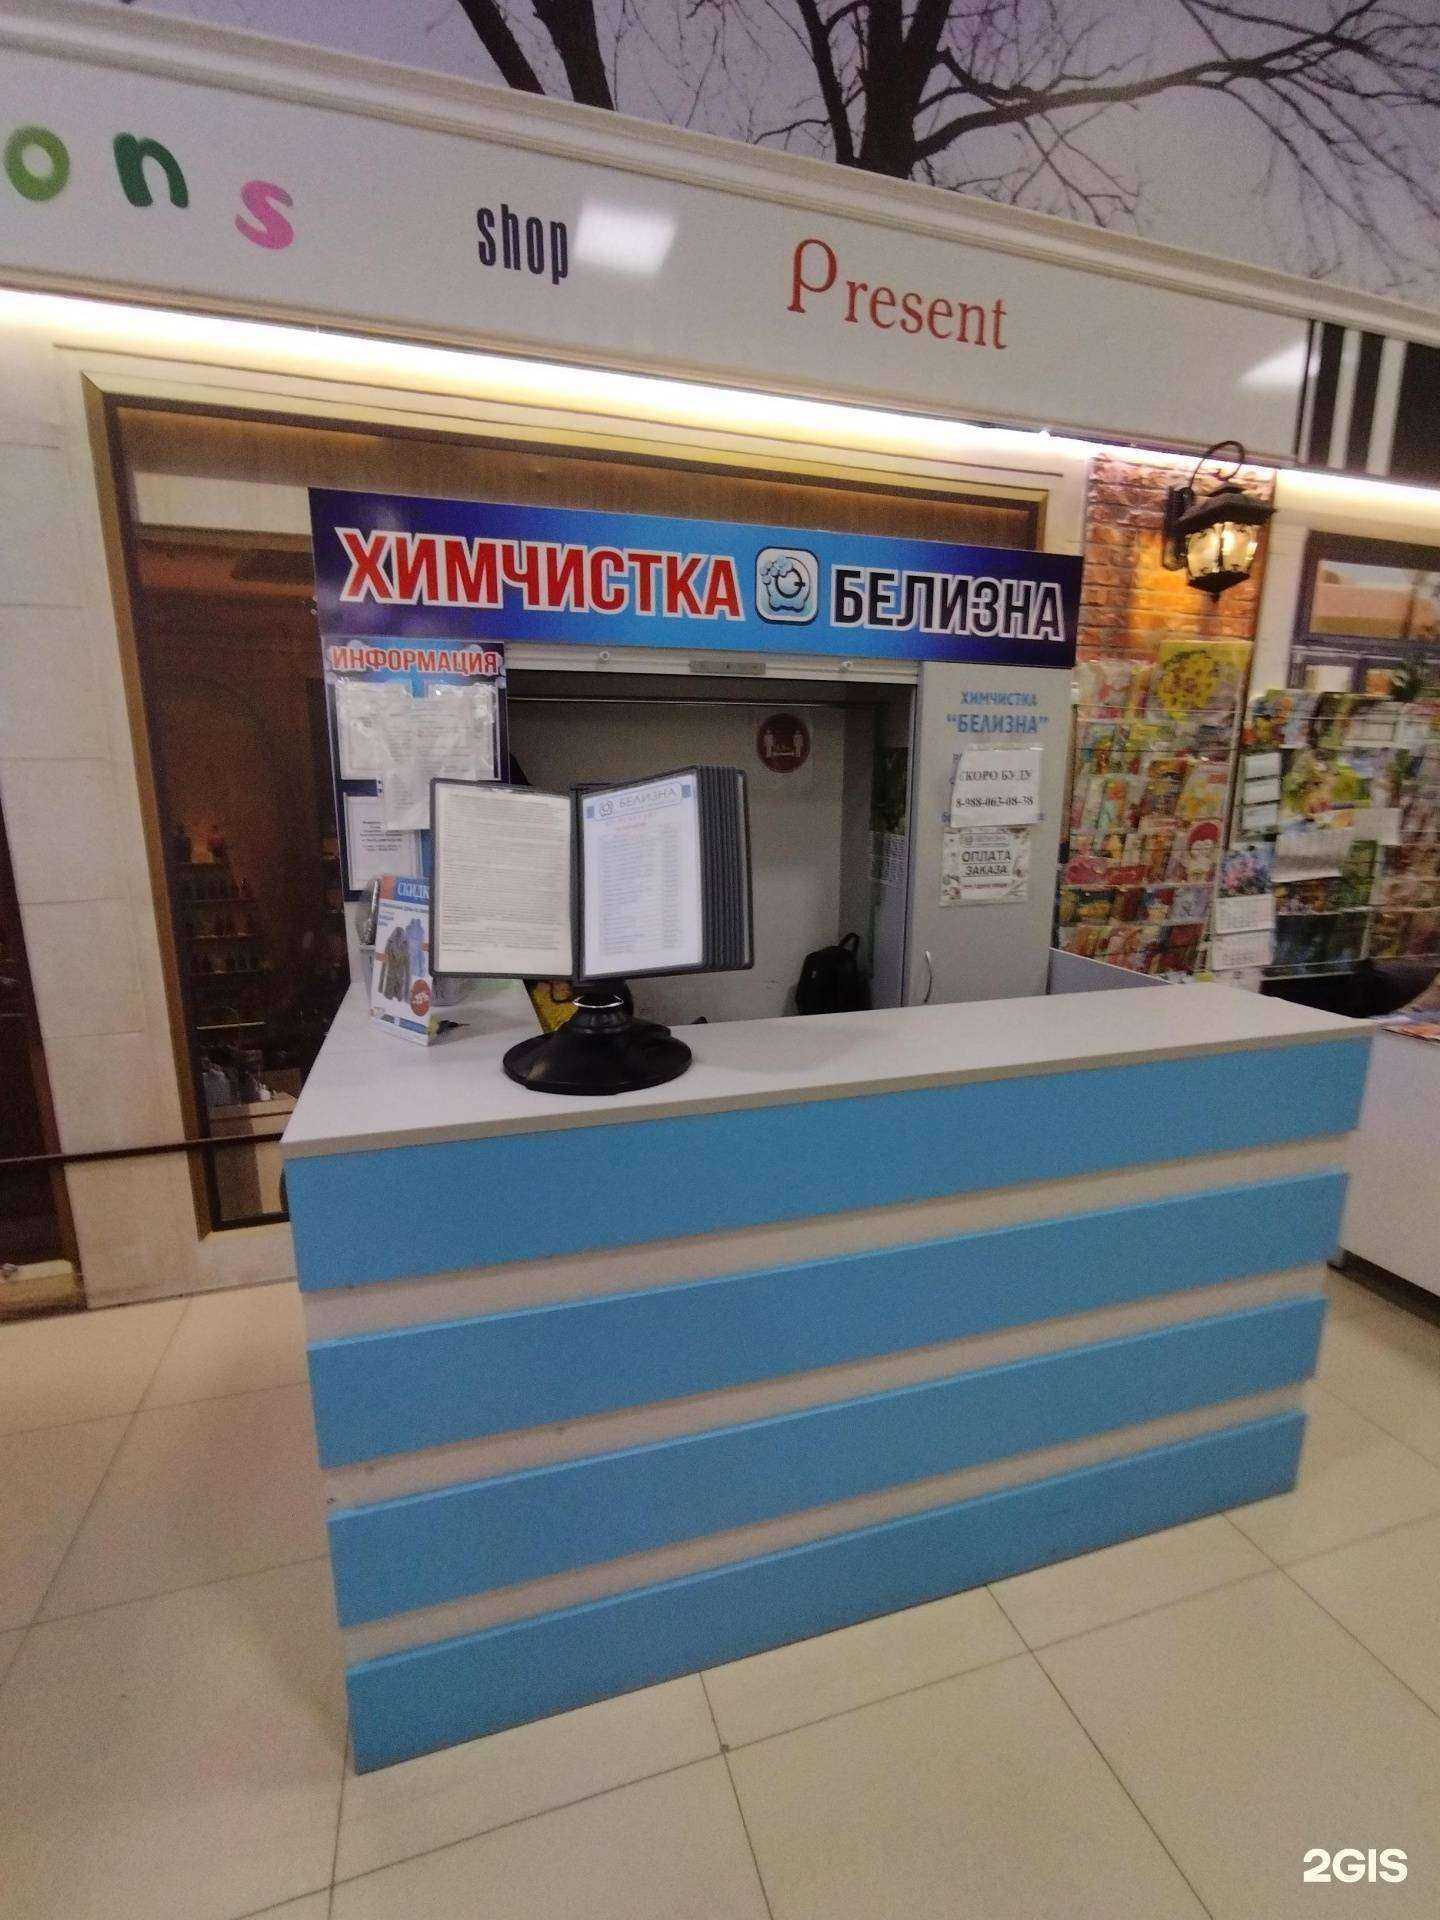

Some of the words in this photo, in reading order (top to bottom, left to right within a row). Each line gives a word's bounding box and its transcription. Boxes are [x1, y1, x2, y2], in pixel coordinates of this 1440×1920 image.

[477, 204, 570, 285] shop
[787, 238, 1008, 350] Present
[334, 527, 746, 622] ХИМЧИСТКА
[830, 564, 1066, 642] БЕЛИЗНА
[332, 646, 499, 676] ИНФОРМАЦИЯ
[960, 690, 1038, 707] ХИМЧИСТКА
[961, 850, 1011, 863] ОПЛАТА
[965, 865, 1007, 876] ЗАКАЗА
